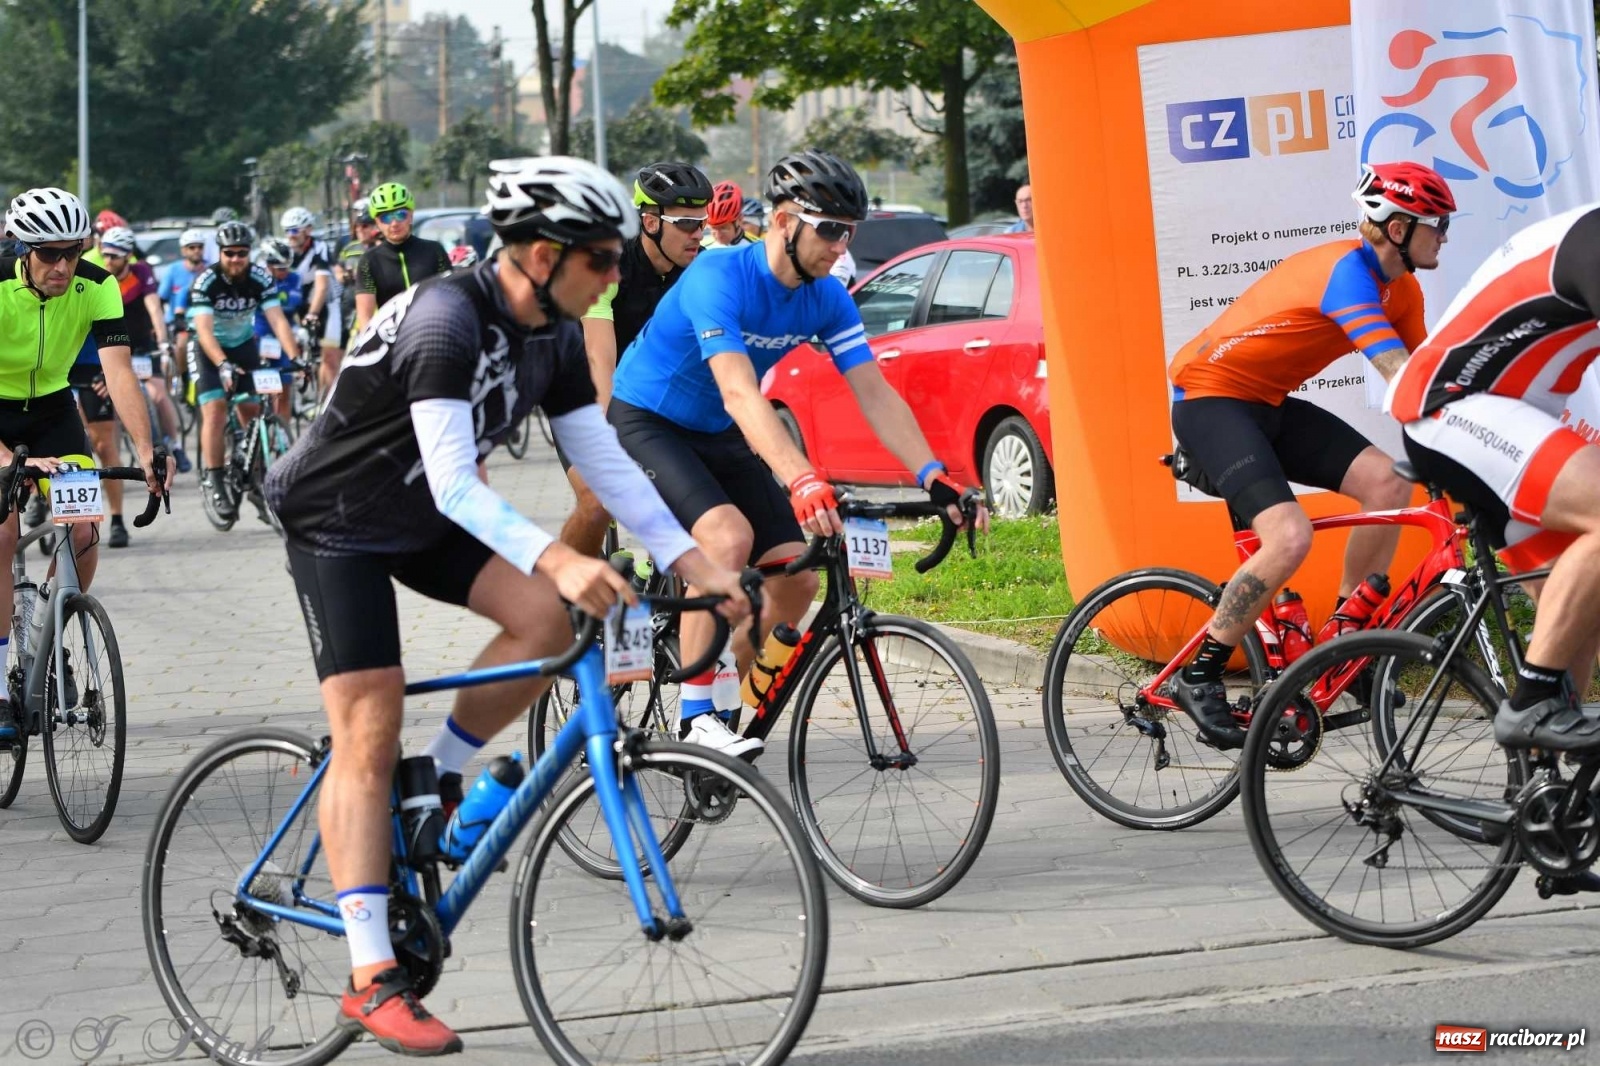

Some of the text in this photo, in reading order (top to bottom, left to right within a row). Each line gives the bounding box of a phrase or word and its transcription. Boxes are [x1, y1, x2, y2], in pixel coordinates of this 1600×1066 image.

[1382, 180, 1416, 197] KASK
[1211, 231, 1258, 246] Projekt
[1262, 231, 1271, 241] o
[1274, 226, 1327, 240] numerze
[1177, 266, 1198, 278] PL.
[1190, 296, 1213, 311] jest
[55, 487, 98, 504] 1187
[851, 536, 888, 557] 1137
